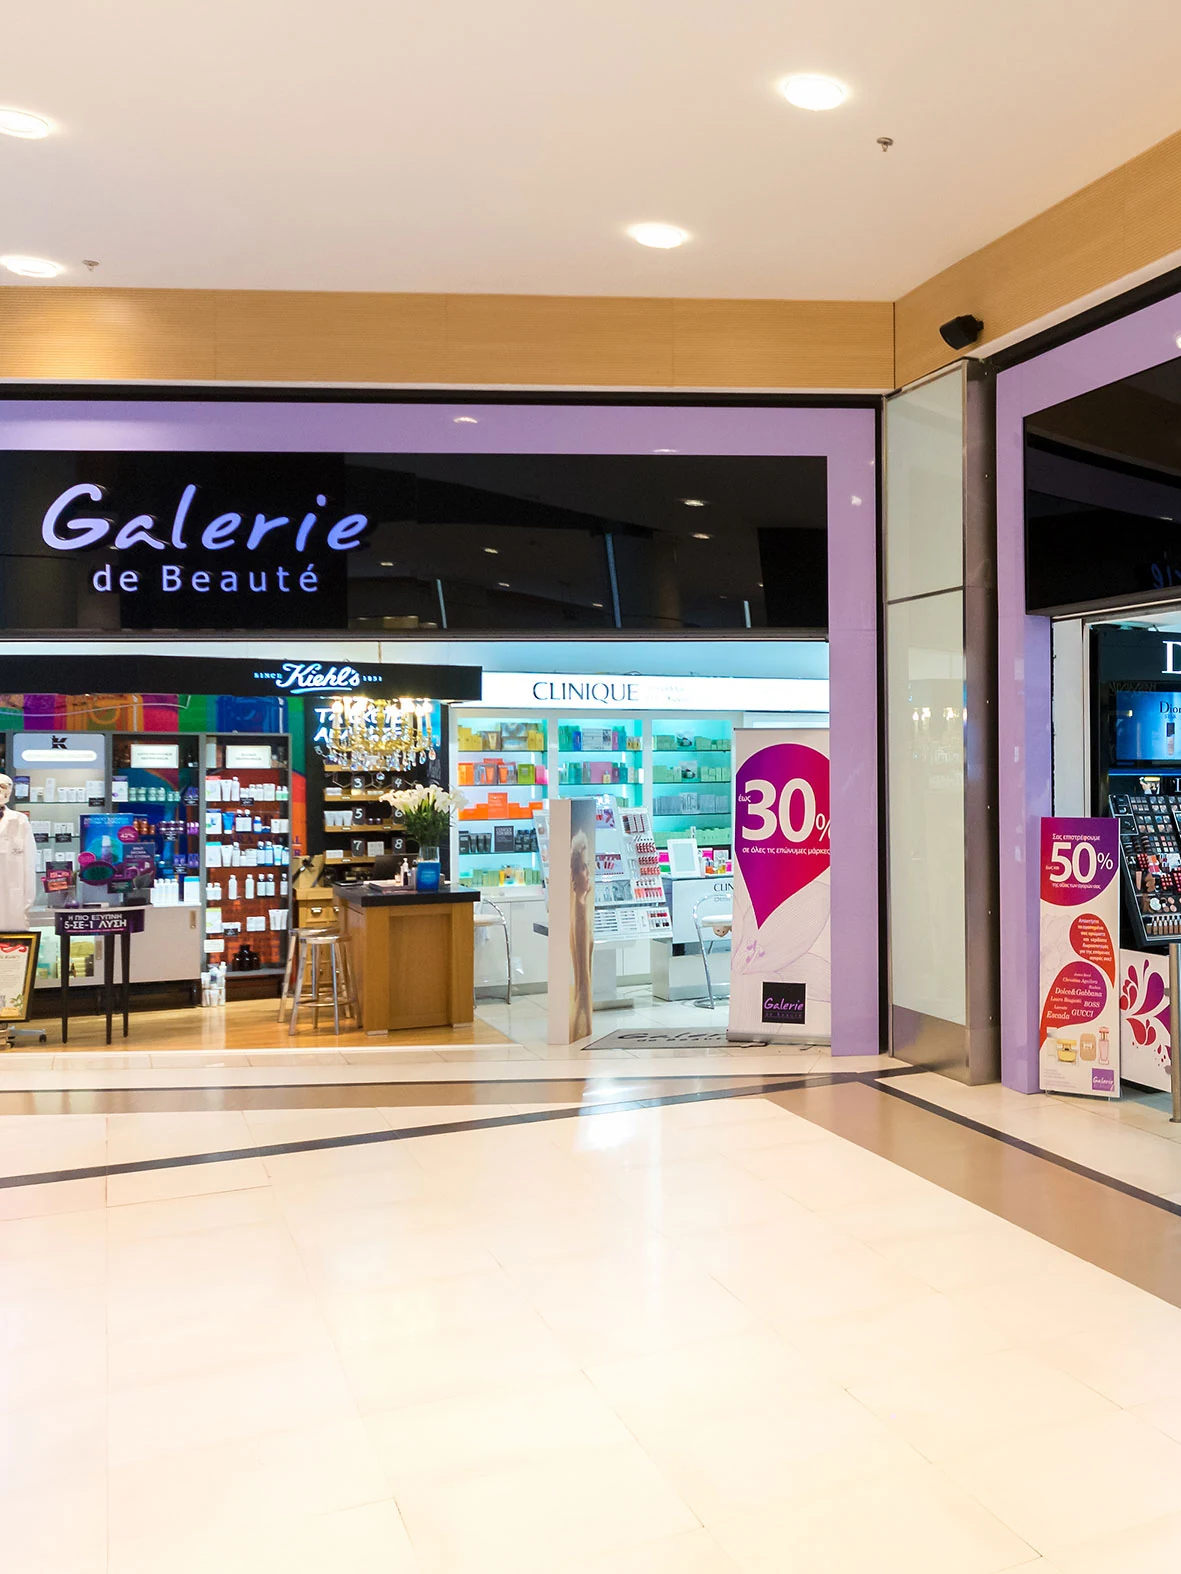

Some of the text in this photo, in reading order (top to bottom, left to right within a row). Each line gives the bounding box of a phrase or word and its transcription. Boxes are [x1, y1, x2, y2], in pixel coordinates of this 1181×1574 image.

[42, 483, 369, 552] Galerie
[93, 563, 320, 592] de Beauté
[276, 663, 360, 688] Kiehl's
[533, 681, 640, 704] CLINIQUE
[354, 778, 362, 788] 3
[738, 793, 752, 803] έως
[355, 808, 363, 819] 5
[353, 838, 403, 850] 7 8
[751, 846, 767, 855] όλες
[1050, 842, 1114, 883] 50%
[99, 919, 127, 929] ΛΥΣΗ
[763, 997, 804, 1010] Galerie
[1046, 1010, 1070, 1020] Escada
[1071, 1008, 1094, 1018] GUCCI
